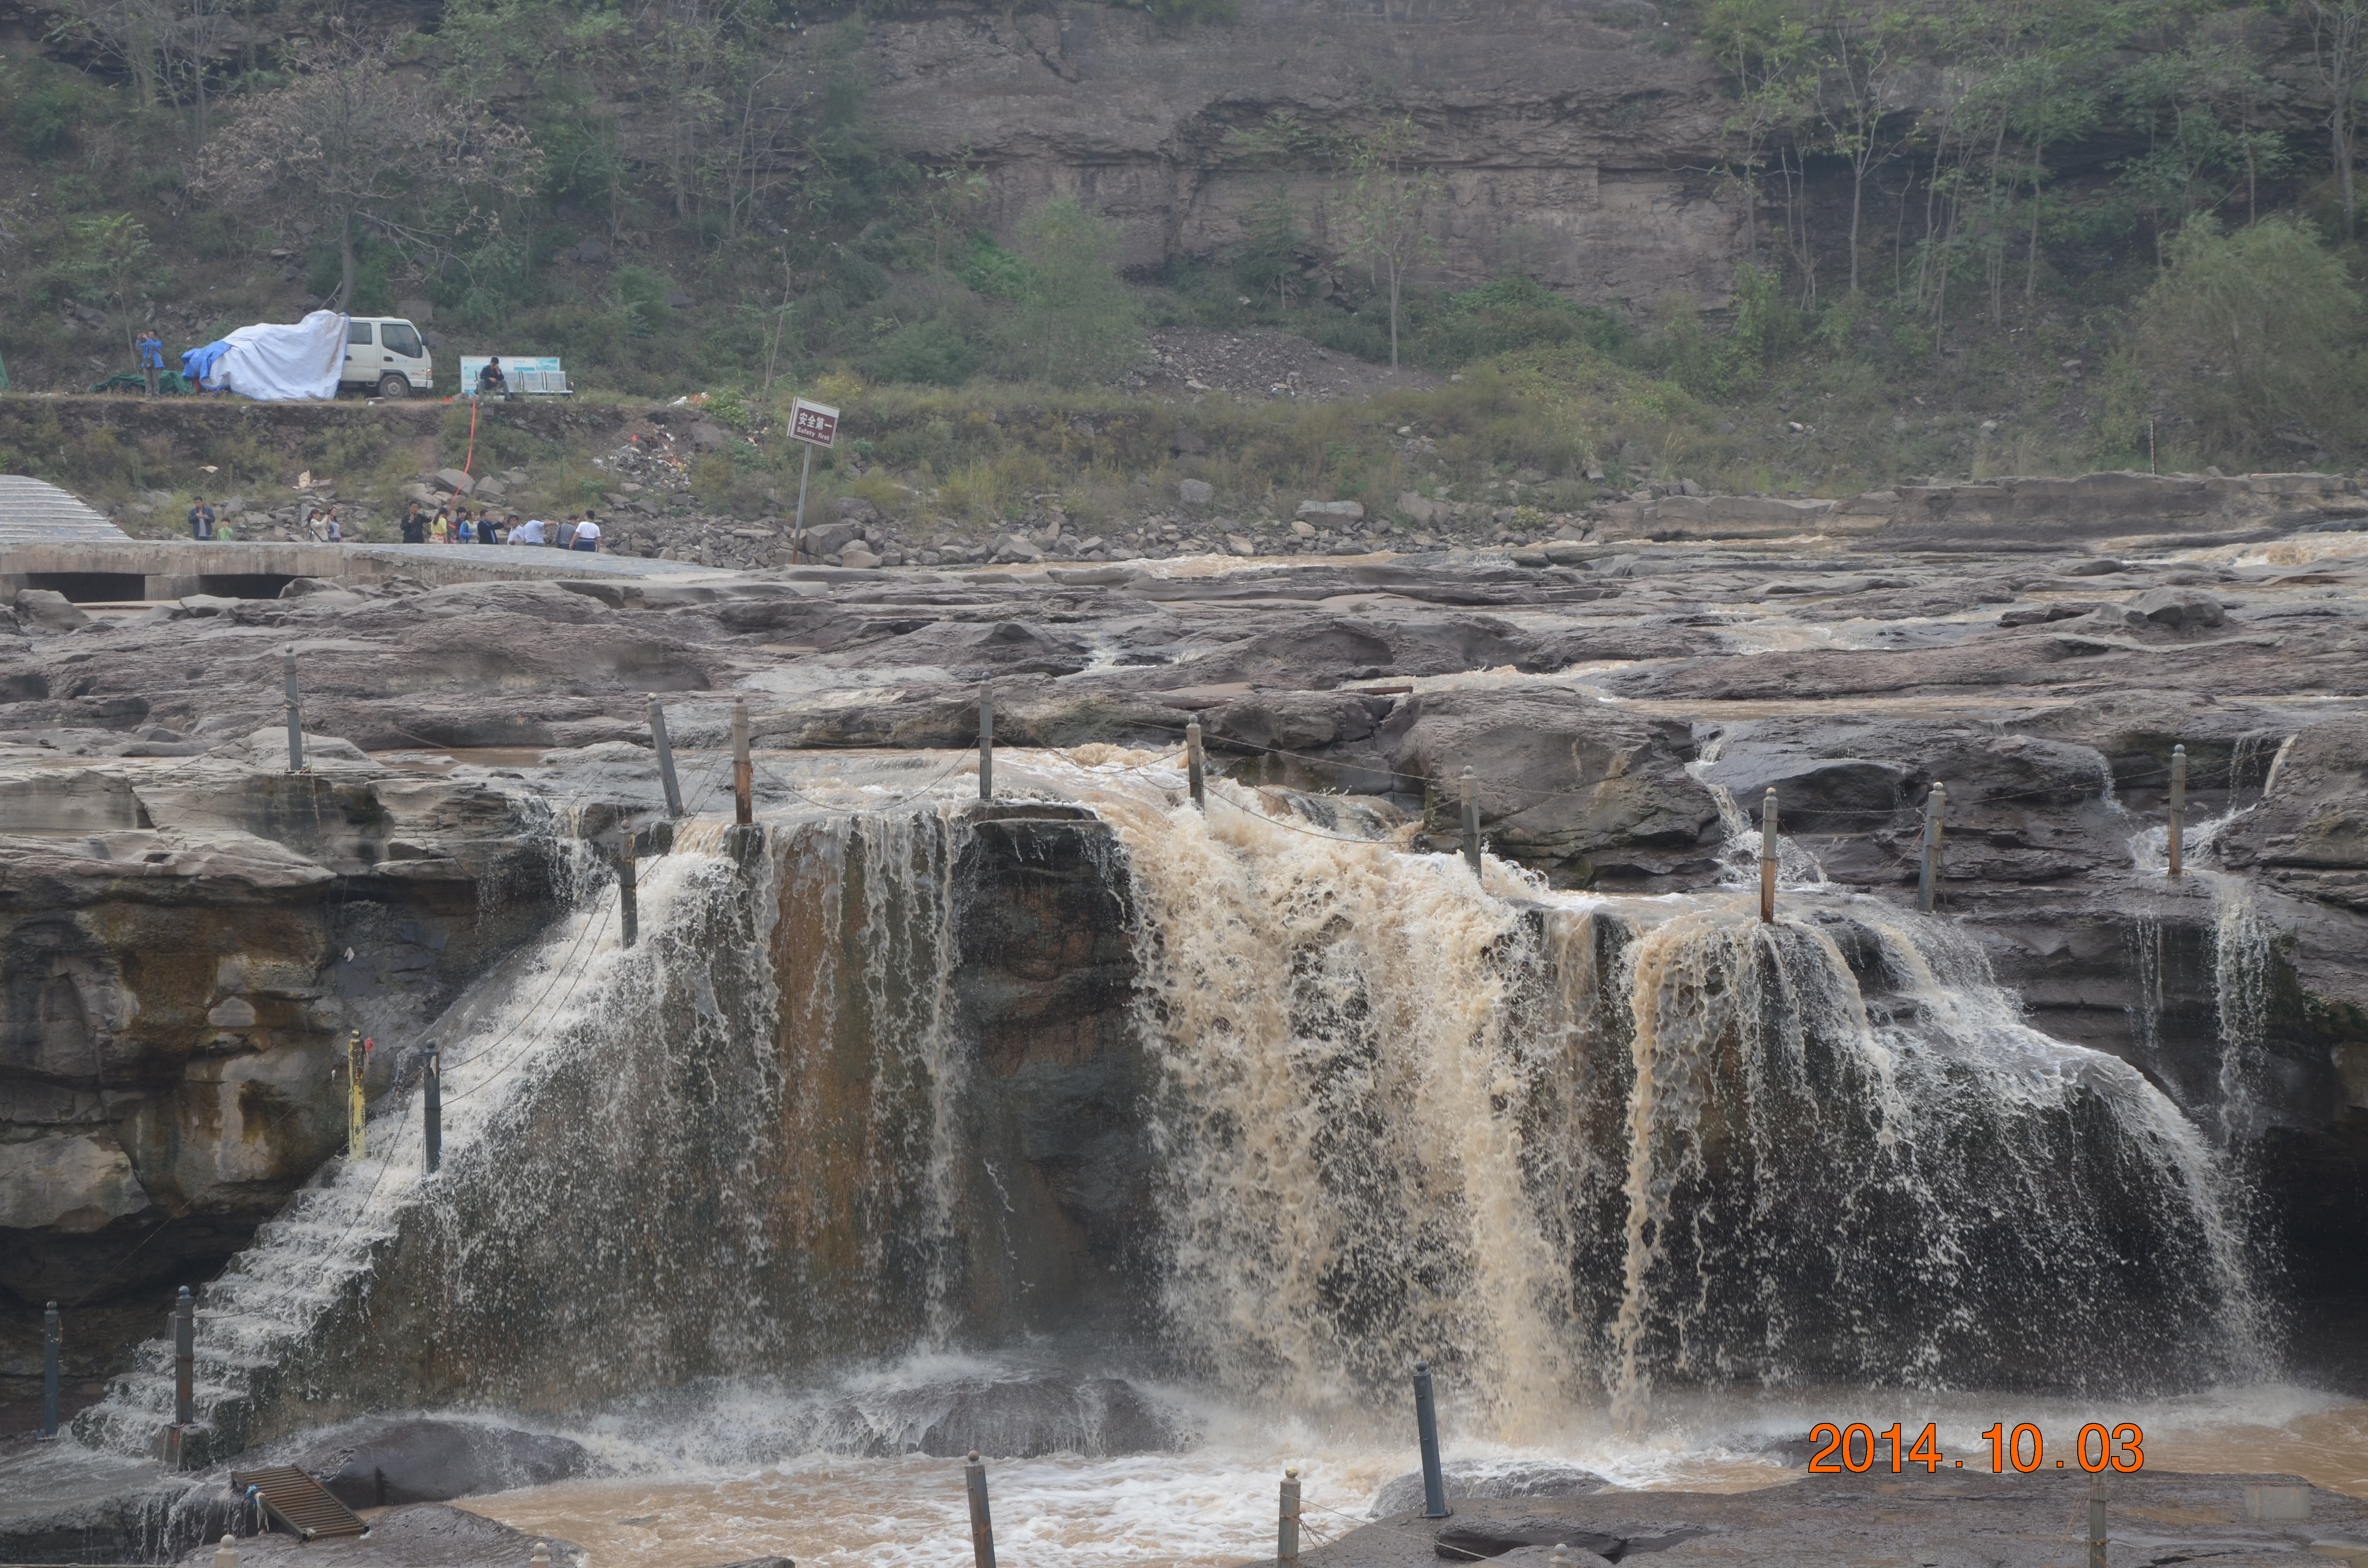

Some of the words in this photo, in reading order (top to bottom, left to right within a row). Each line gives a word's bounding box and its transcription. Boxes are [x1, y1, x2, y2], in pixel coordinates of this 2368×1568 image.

[799, 412, 833, 430] 安全第一
[797, 427, 815, 437] Safety
[818, 432, 830, 441] first
